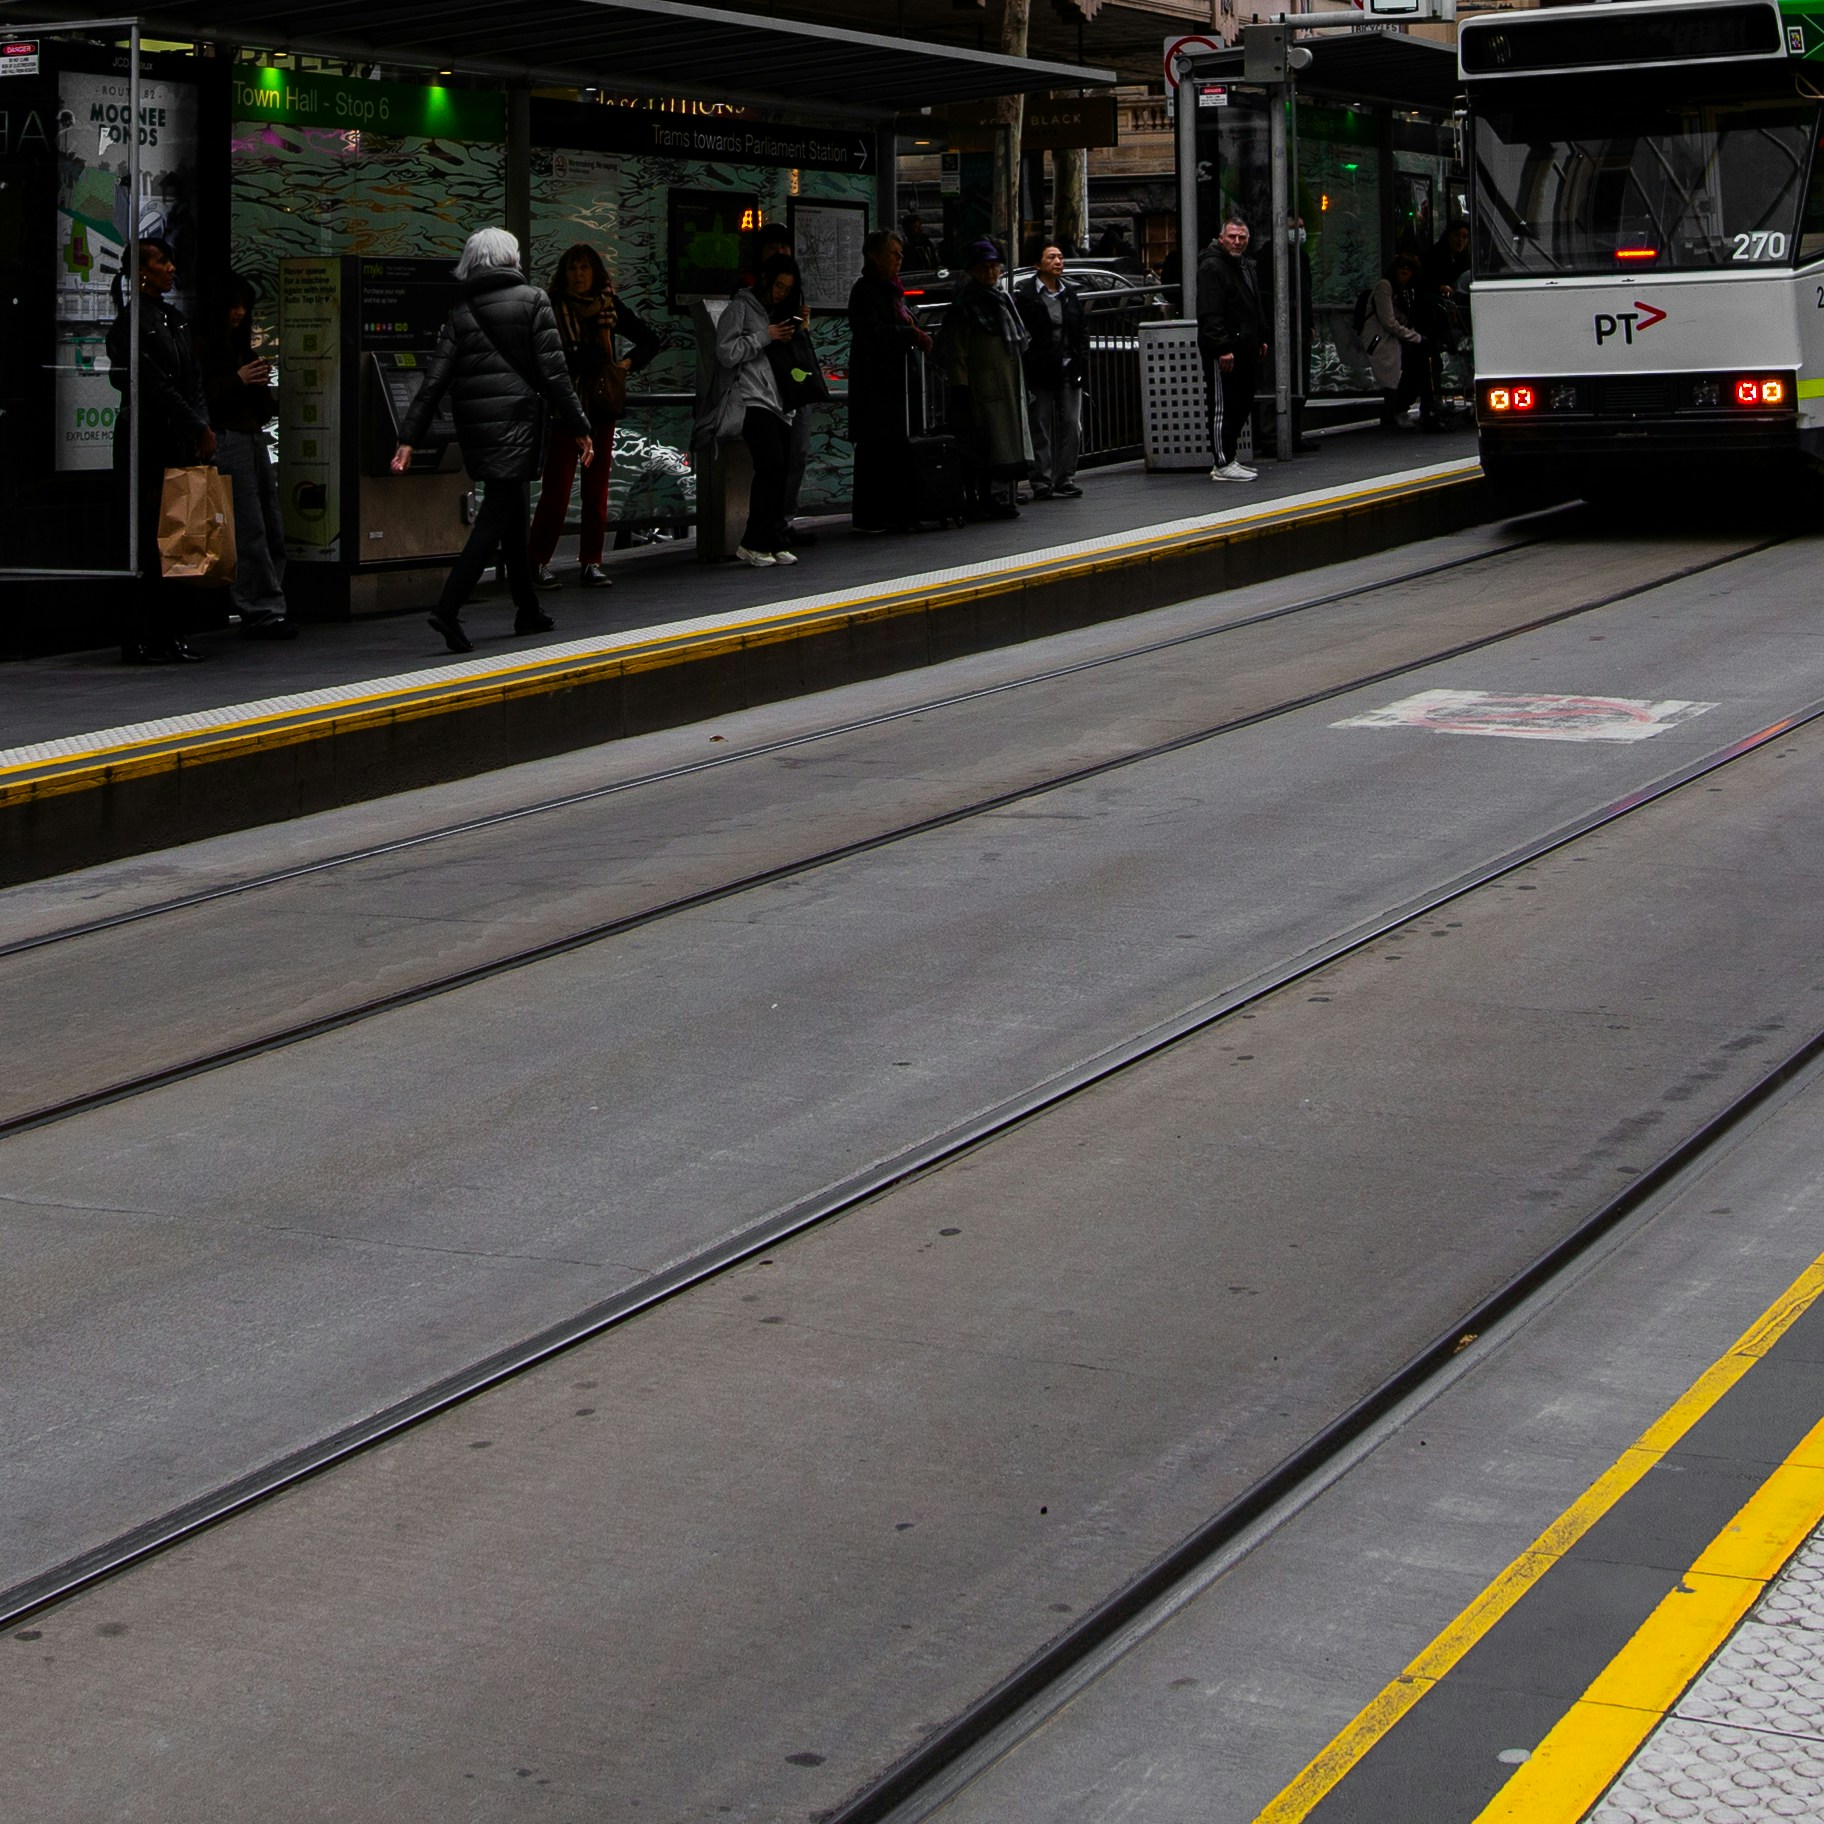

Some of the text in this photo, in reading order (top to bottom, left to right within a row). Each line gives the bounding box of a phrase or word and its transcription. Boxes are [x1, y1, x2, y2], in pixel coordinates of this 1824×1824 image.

[6, 44, 33, 55] DANGER
[102, 85, 132, 97] ROUT
[233, 80, 280, 109] Town
[286, 86, 318, 113] Hall
[336, 91, 375, 123] Stop
[379, 97, 390, 120] 6
[1030, 113, 1081, 126] BLACK
[652, 124, 847, 163] Trams towards Parliament Station
[1732, 231, 1786, 260] 270
[76, 408, 119, 427] FOO
[66, 430, 100, 442] EXPLORE
